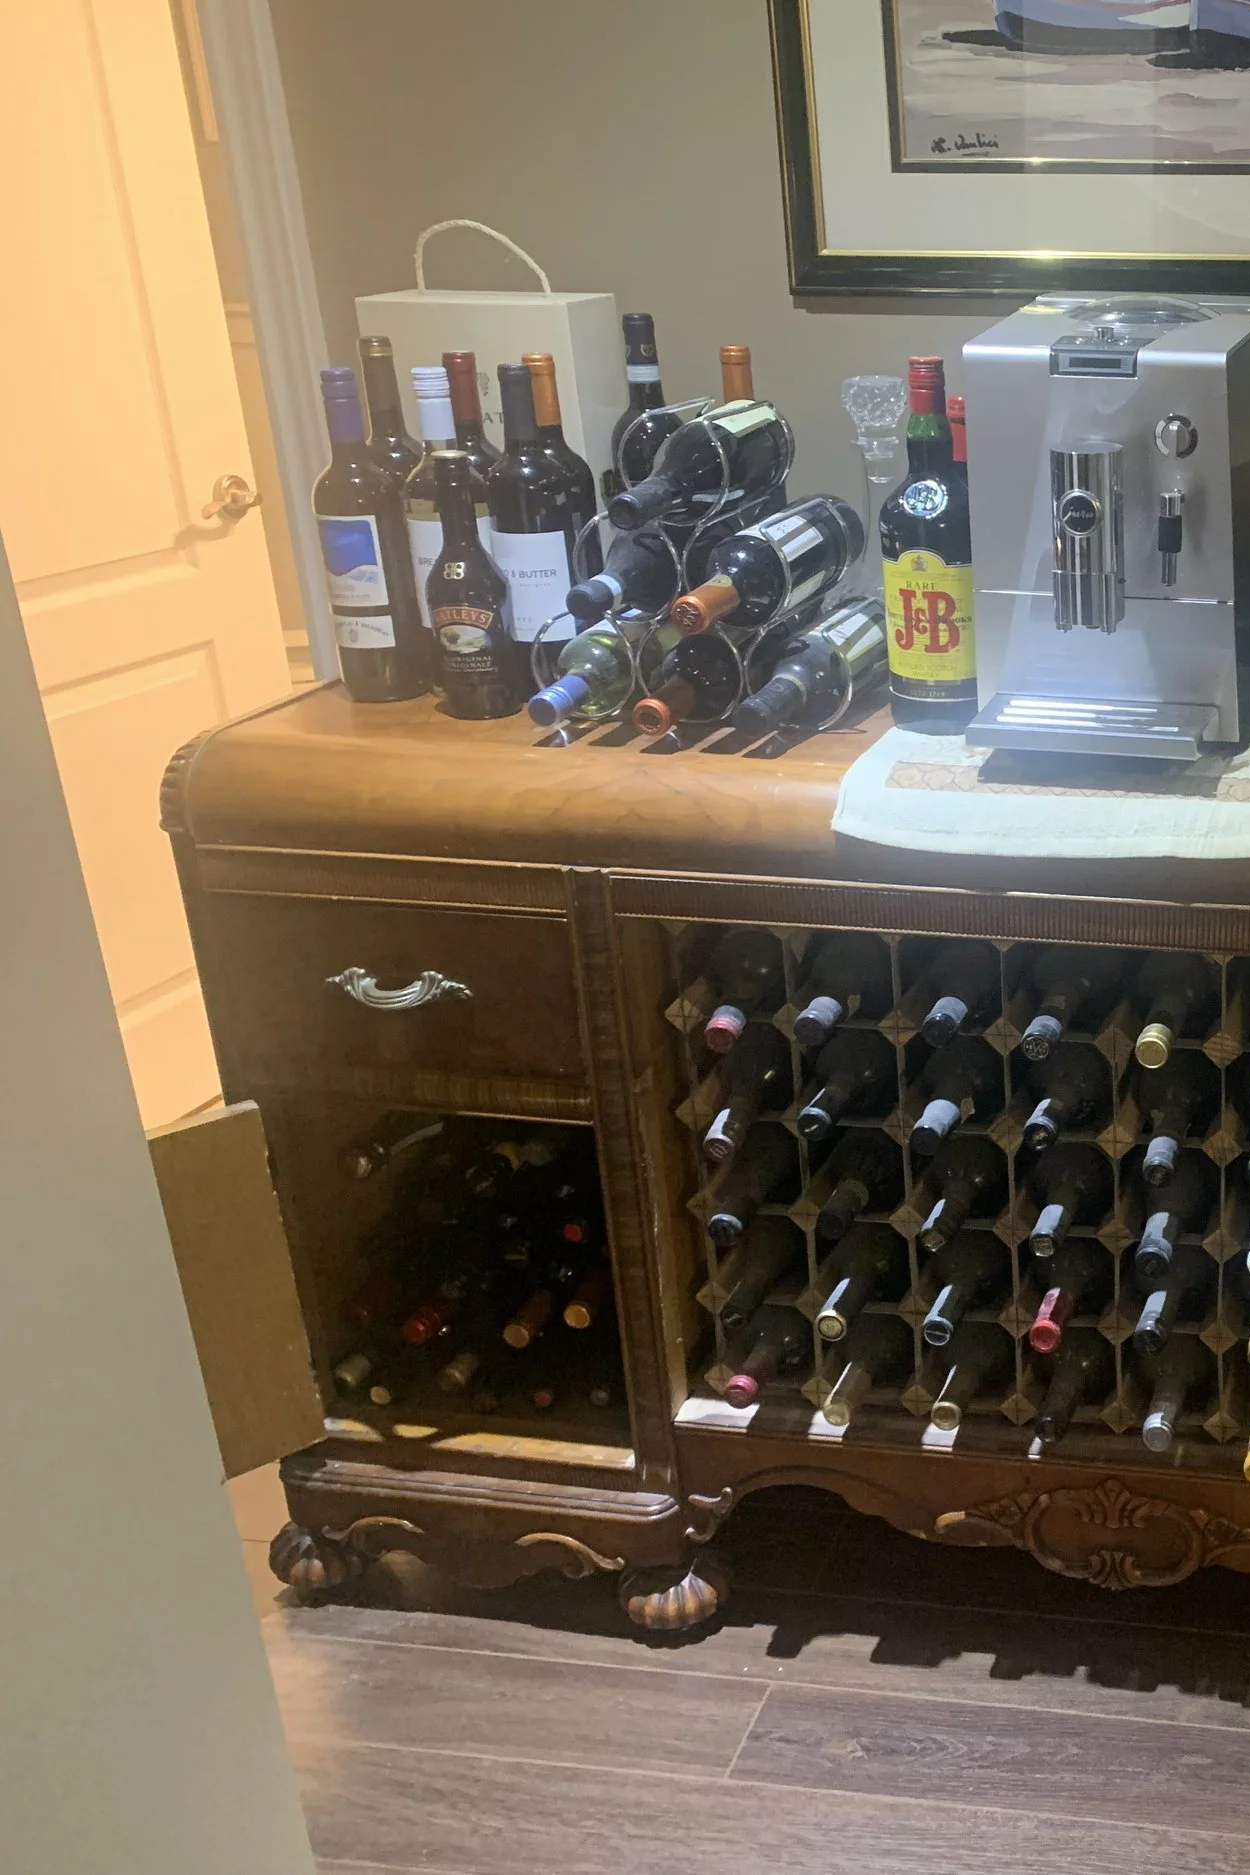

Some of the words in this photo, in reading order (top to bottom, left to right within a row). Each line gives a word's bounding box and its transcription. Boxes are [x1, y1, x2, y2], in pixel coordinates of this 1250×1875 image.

[518, 568, 557, 579] BUTTER
[905, 581, 937, 591] RARE
[436, 608, 490, 624] AILEYS
[895, 587, 961, 654] J&B
